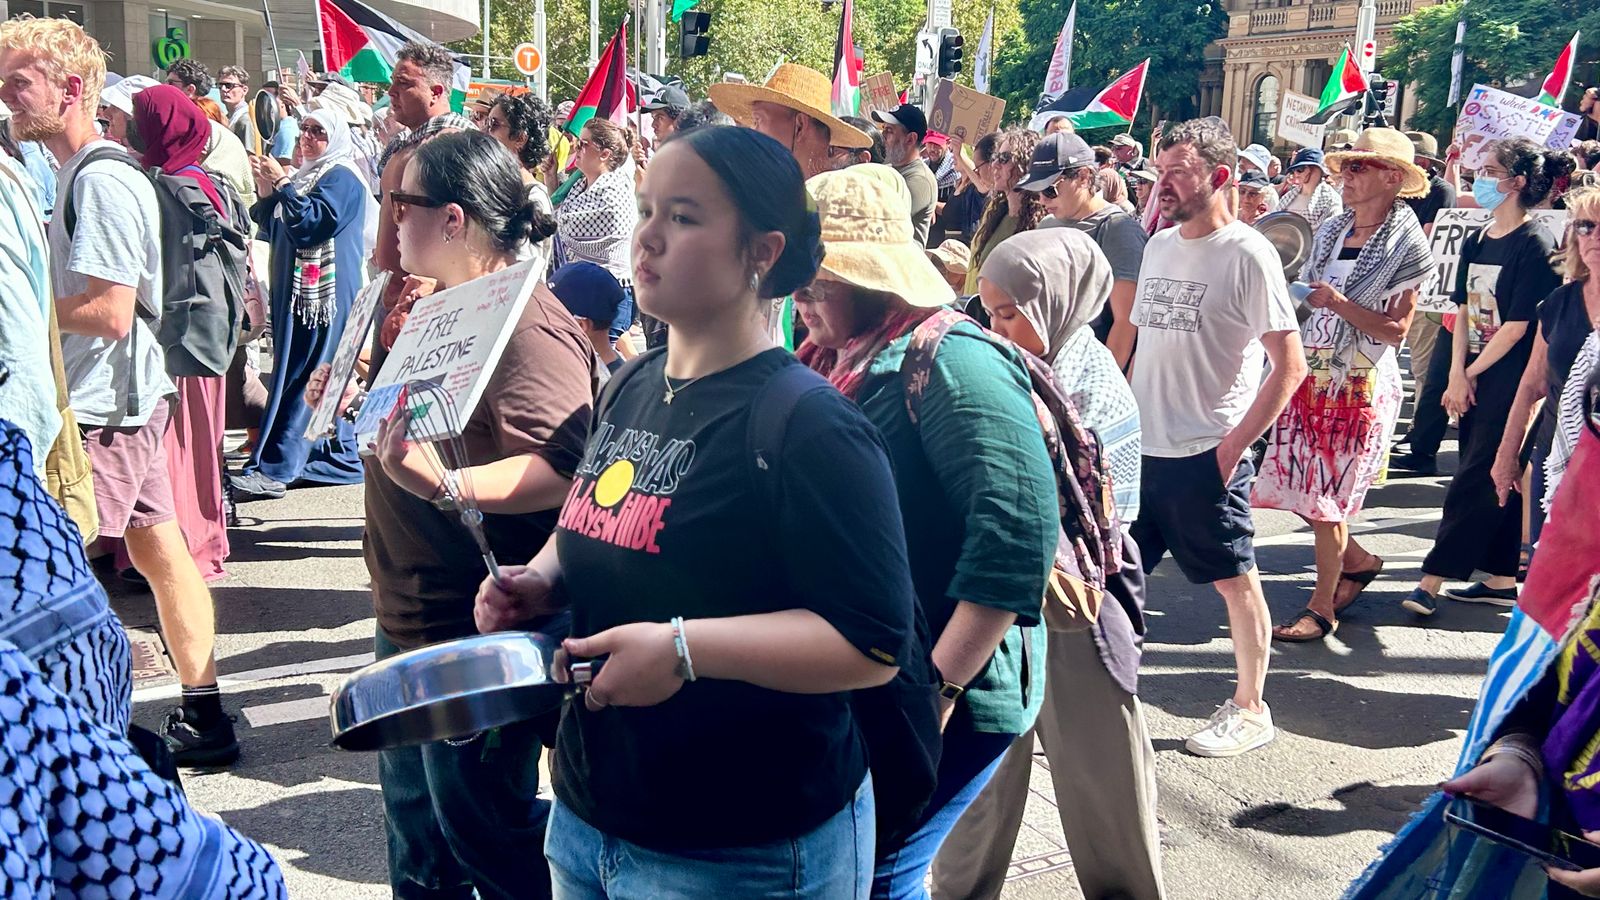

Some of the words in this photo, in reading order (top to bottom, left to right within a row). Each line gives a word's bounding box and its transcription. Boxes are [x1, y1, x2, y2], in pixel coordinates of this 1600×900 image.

[523, 51, 535, 69] T
[417, 308, 463, 348] FREE
[393, 335, 477, 383] PALESTINE
[1267, 412, 1371, 453] EASEFIR
[1287, 446, 1355, 496] NOW
